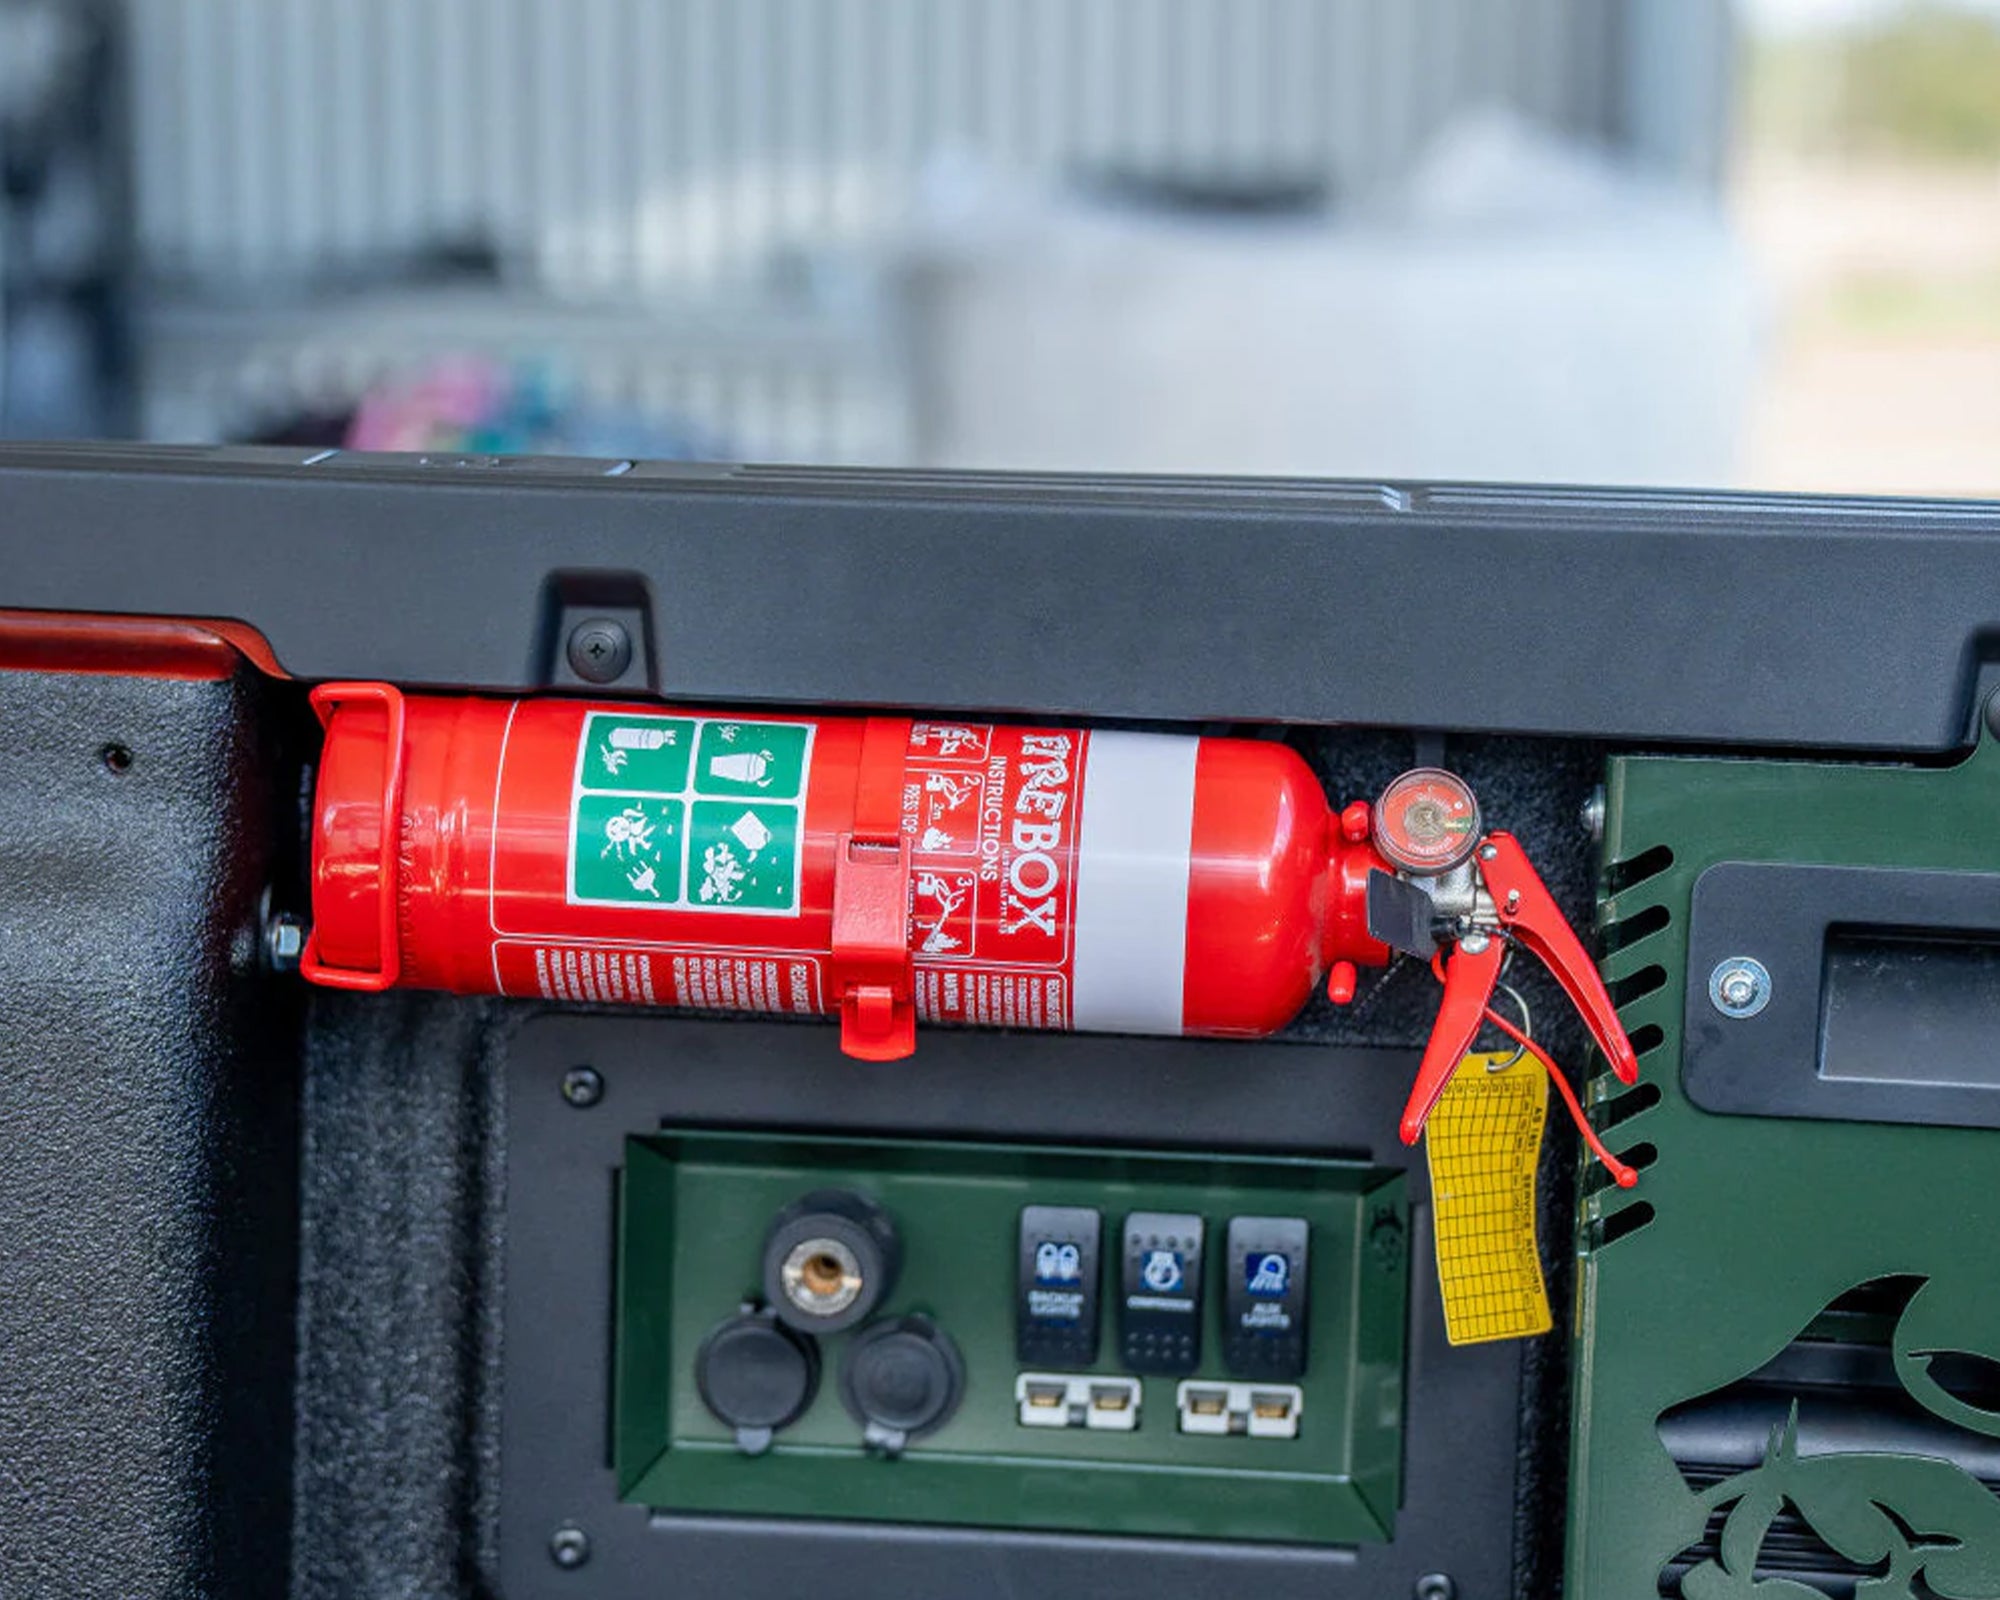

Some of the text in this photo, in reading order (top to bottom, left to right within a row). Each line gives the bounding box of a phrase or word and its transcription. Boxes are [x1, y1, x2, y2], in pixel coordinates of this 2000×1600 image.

[963, 776, 981, 787] 2
[902, 784, 921, 834] PRESS TOP
[932, 803, 945, 820] 2m
[980, 756, 1008, 882] INSTRUCTIONS
[1009, 735, 1072, 937] FIREBOX
[956, 876, 974, 887] 3
[1523, 1174, 1533, 1229] SERVICE
[1524, 1239, 1542, 1295] RECORD
